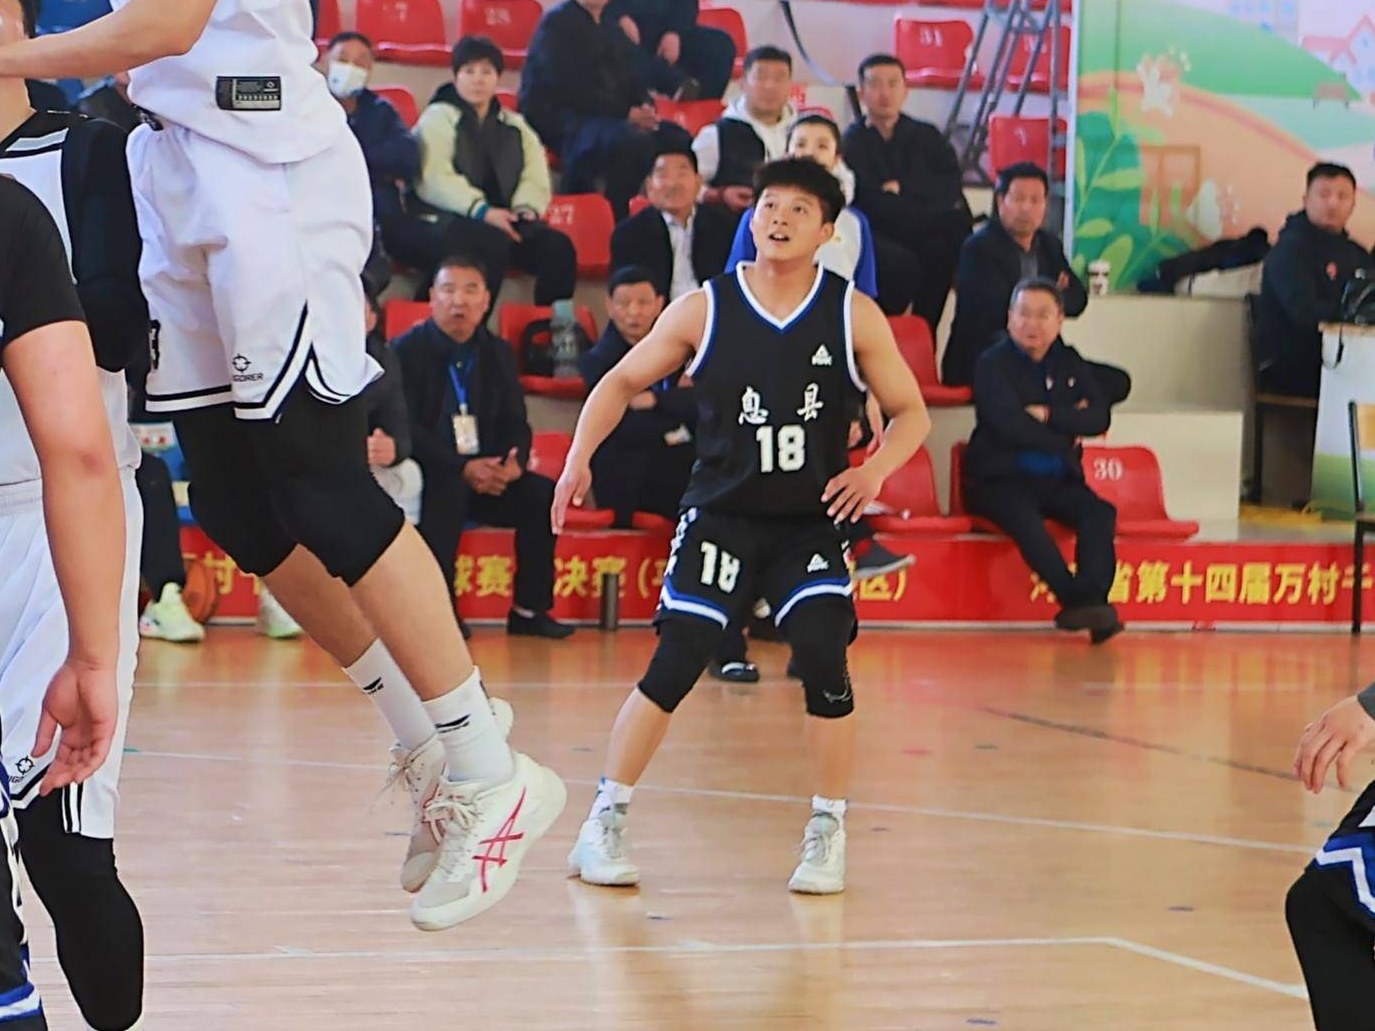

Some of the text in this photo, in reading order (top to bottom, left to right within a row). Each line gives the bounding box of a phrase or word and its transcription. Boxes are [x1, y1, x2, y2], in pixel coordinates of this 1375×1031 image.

[737, 381, 825, 426] 息县
[756, 423, 806, 473] 18
[1093, 457, 1123, 481] 30
